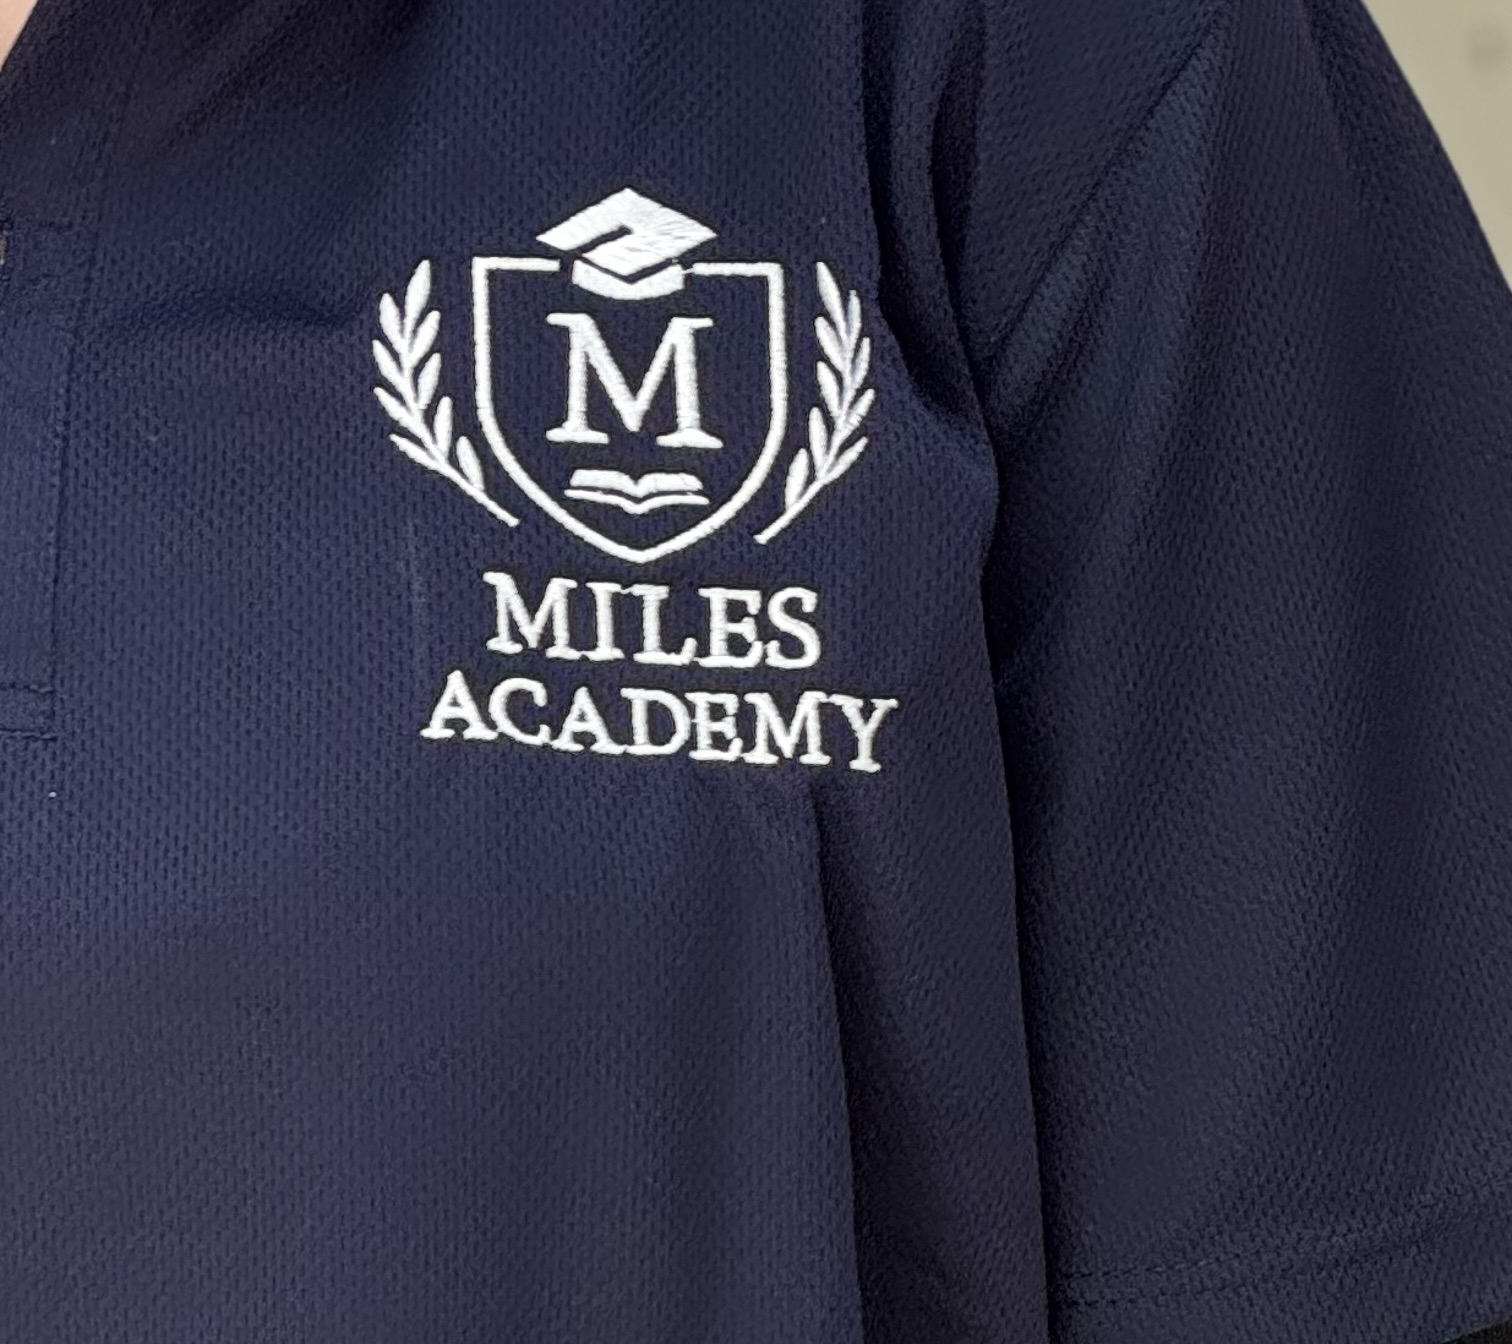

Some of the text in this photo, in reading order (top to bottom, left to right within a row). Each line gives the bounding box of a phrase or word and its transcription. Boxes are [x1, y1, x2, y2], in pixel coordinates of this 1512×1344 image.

[545, 312, 724, 449] M
[482, 571, 821, 670] MILES
[419, 669, 899, 773] ACADEMY
